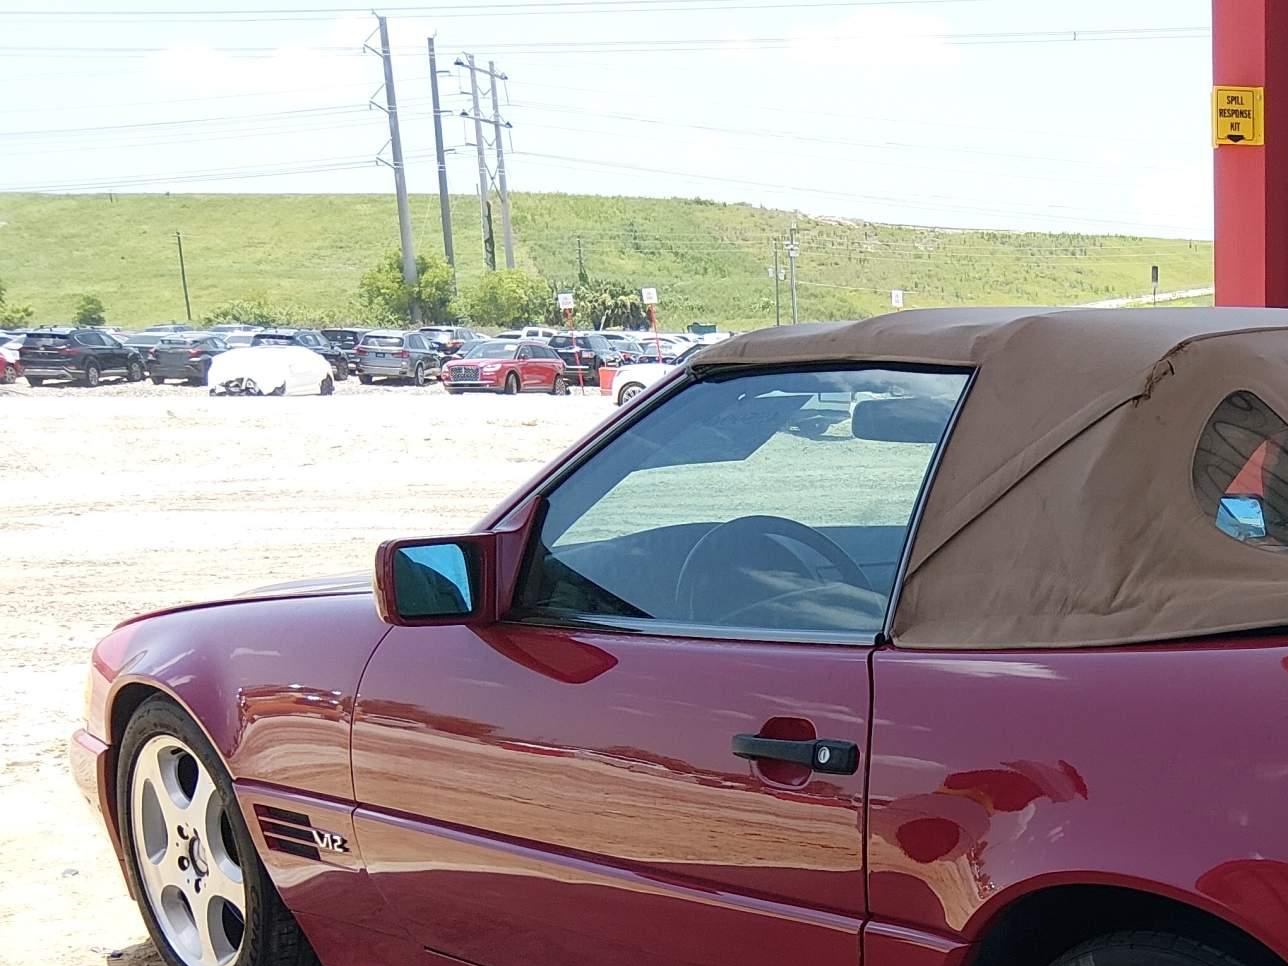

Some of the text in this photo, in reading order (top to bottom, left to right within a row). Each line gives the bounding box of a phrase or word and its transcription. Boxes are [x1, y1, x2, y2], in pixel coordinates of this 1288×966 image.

[1227, 96, 1244, 105] SPILL
[1219, 109, 1251, 119] RESPONSE
[1231, 122, 1240, 131] KIT
[311, 830, 343, 853] V12
